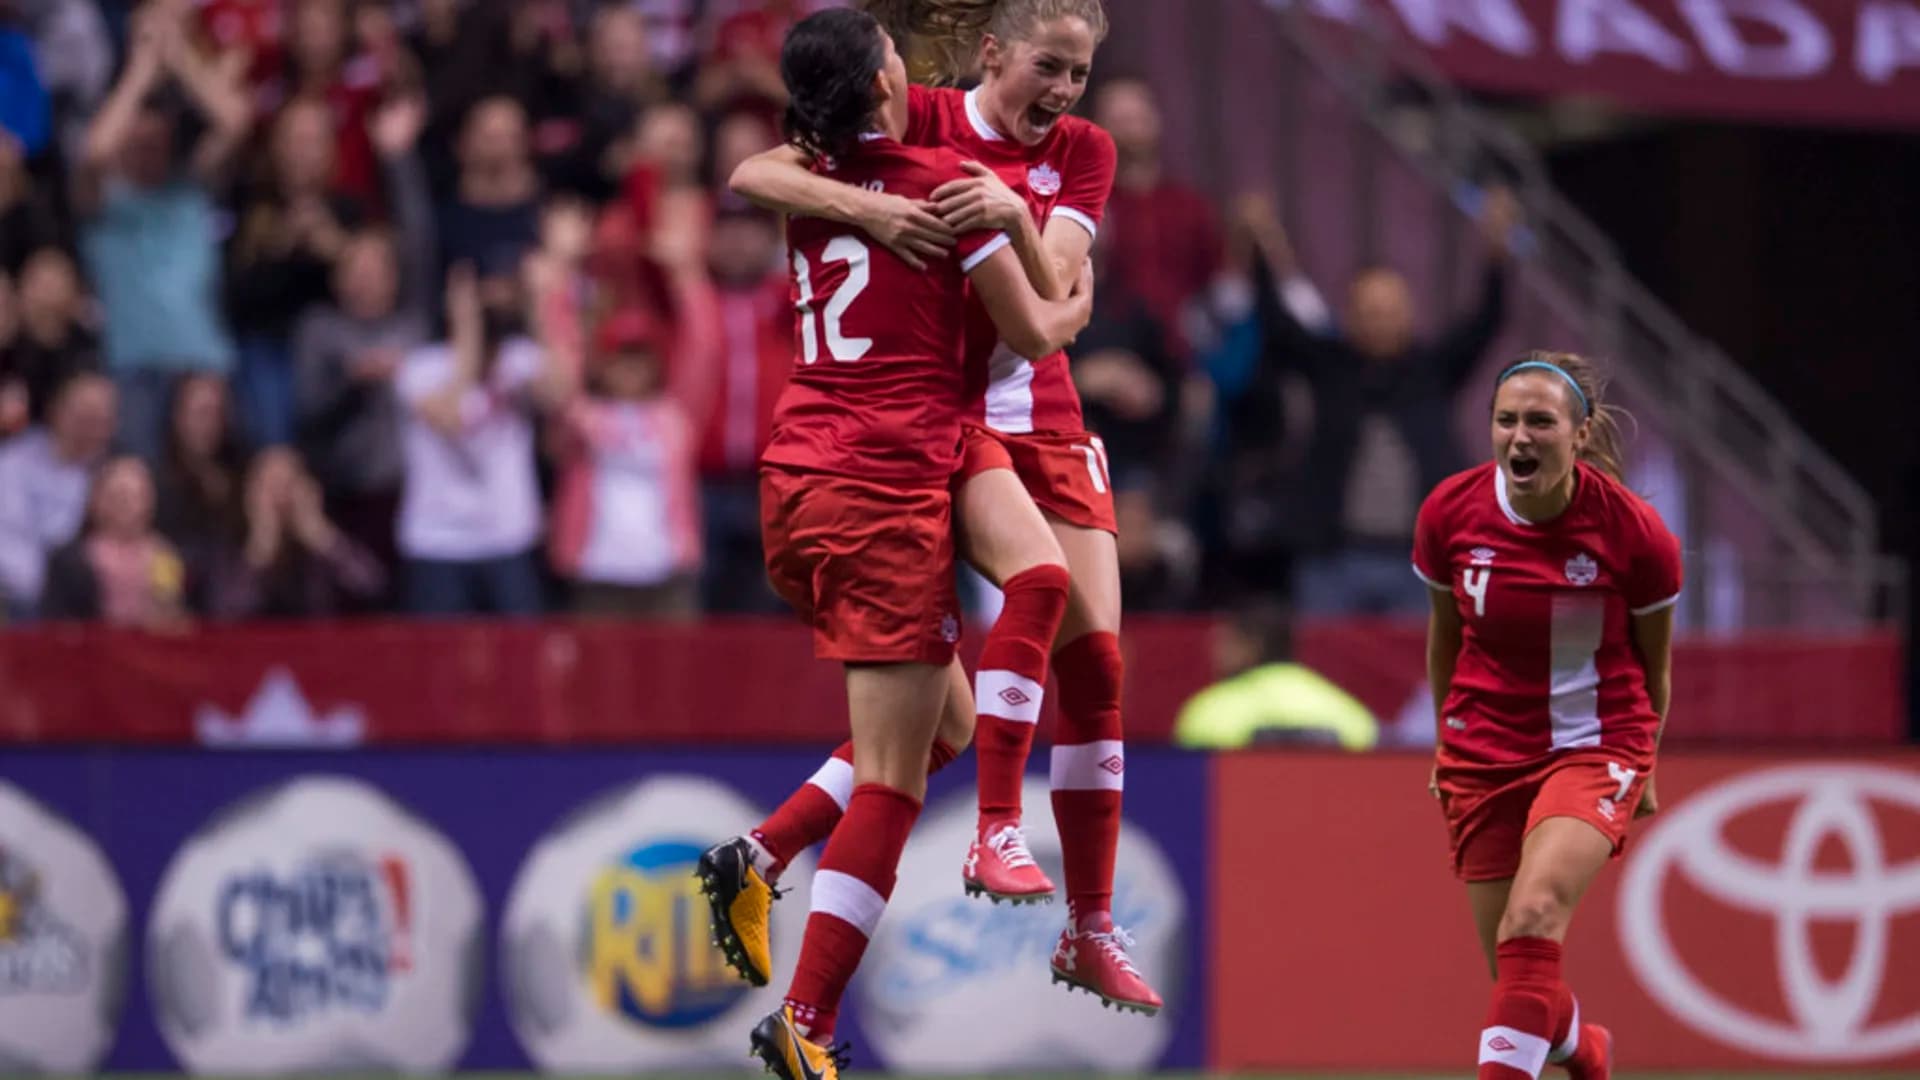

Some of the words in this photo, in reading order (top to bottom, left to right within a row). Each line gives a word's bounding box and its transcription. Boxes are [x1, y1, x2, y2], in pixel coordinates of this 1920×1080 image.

[793, 234, 873, 365] 12
[1463, 568, 1491, 617] 4
[1608, 761, 1636, 802] 4
